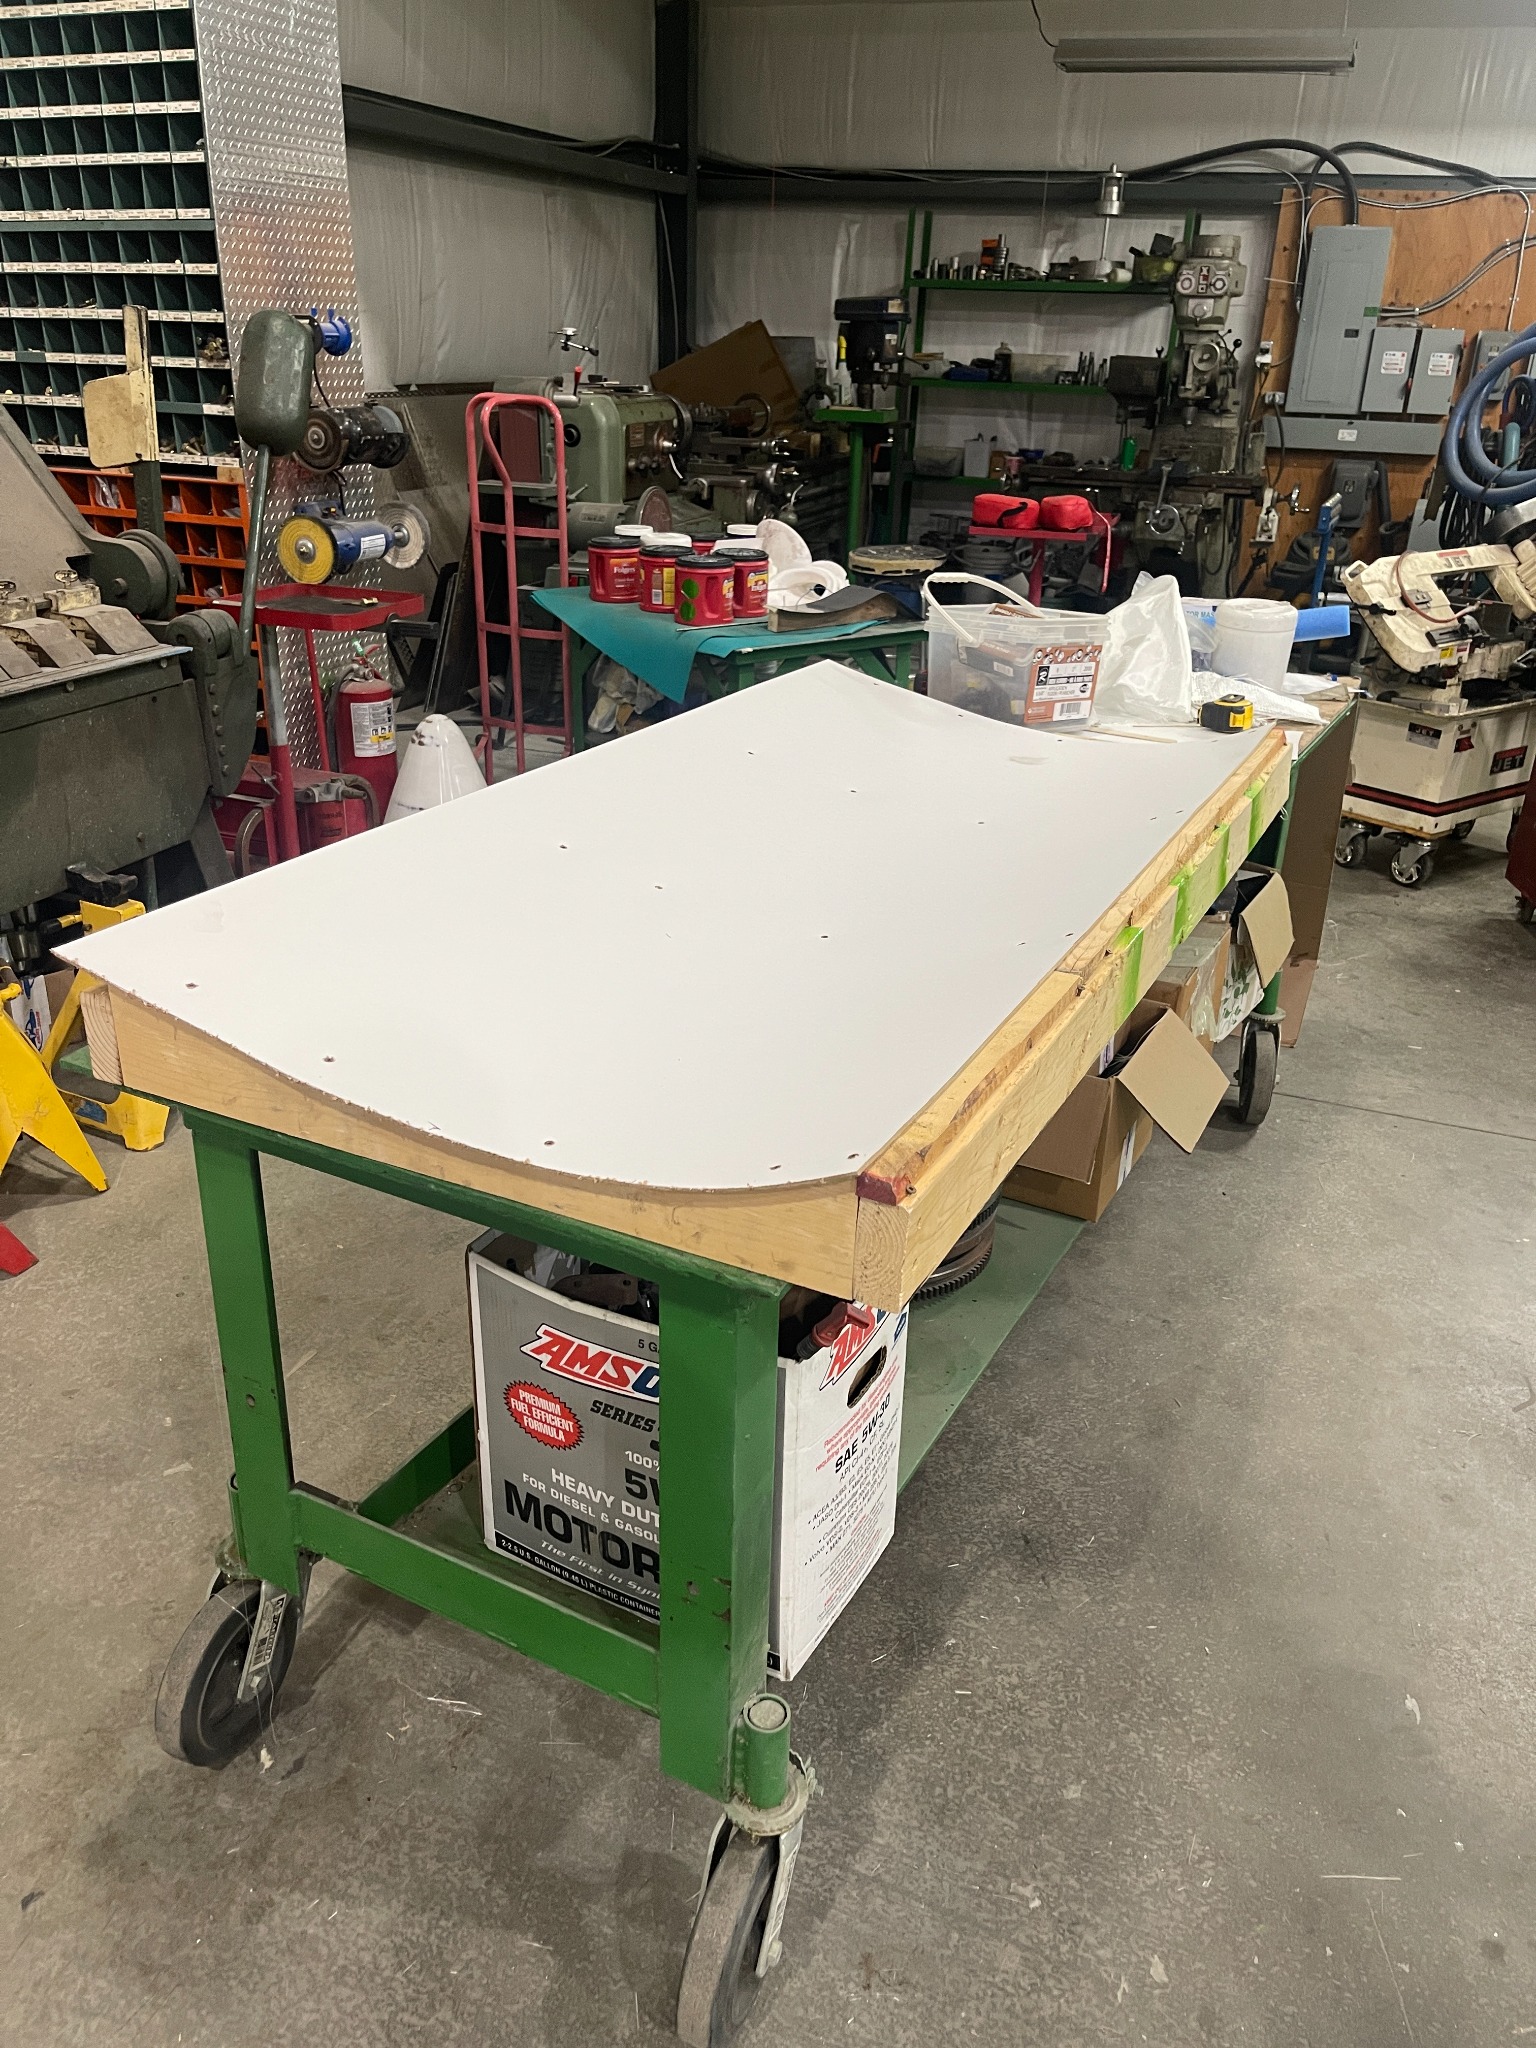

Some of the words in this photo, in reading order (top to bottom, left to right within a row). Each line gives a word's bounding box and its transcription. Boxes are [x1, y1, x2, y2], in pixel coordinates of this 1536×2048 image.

[1443, 555, 1474, 569] JET
[1416, 727, 1434, 737] JET
[1494, 754, 1524, 772] JET
[638, 1338, 645, 1349] 5
[511, 1398, 531, 1417] FUEL
[532, 1406, 574, 1433] EFFICIENT
[519, 1389, 561, 1416] PREMIUM
[590, 1399, 656, 1433] SERIES
[523, 1415, 566, 1442] FORMULA
[835, 1436, 858, 1474] SAE
[862, 1391, 890, 1444] 5W-30
[839, 1463, 850, 1484] API
[523, 1472, 546, 1494] FOR
[550, 1488, 596, 1518] DIESEL
[600, 1512, 610, 1523] &
[551, 1468, 615, 1508] HEAVY
[812, 1499, 829, 1525] ACEA
[817, 1504, 833, 1529] JASO
[504, 1479, 660, 1584] MOTOR
[541, 1540, 566, 1558] The
[569, 1555, 604, 1576] First
[608, 1572, 623, 1584] in
[535, 1556, 561, 1576] GALLON
[589, 1581, 619, 1601] PLASTIC
